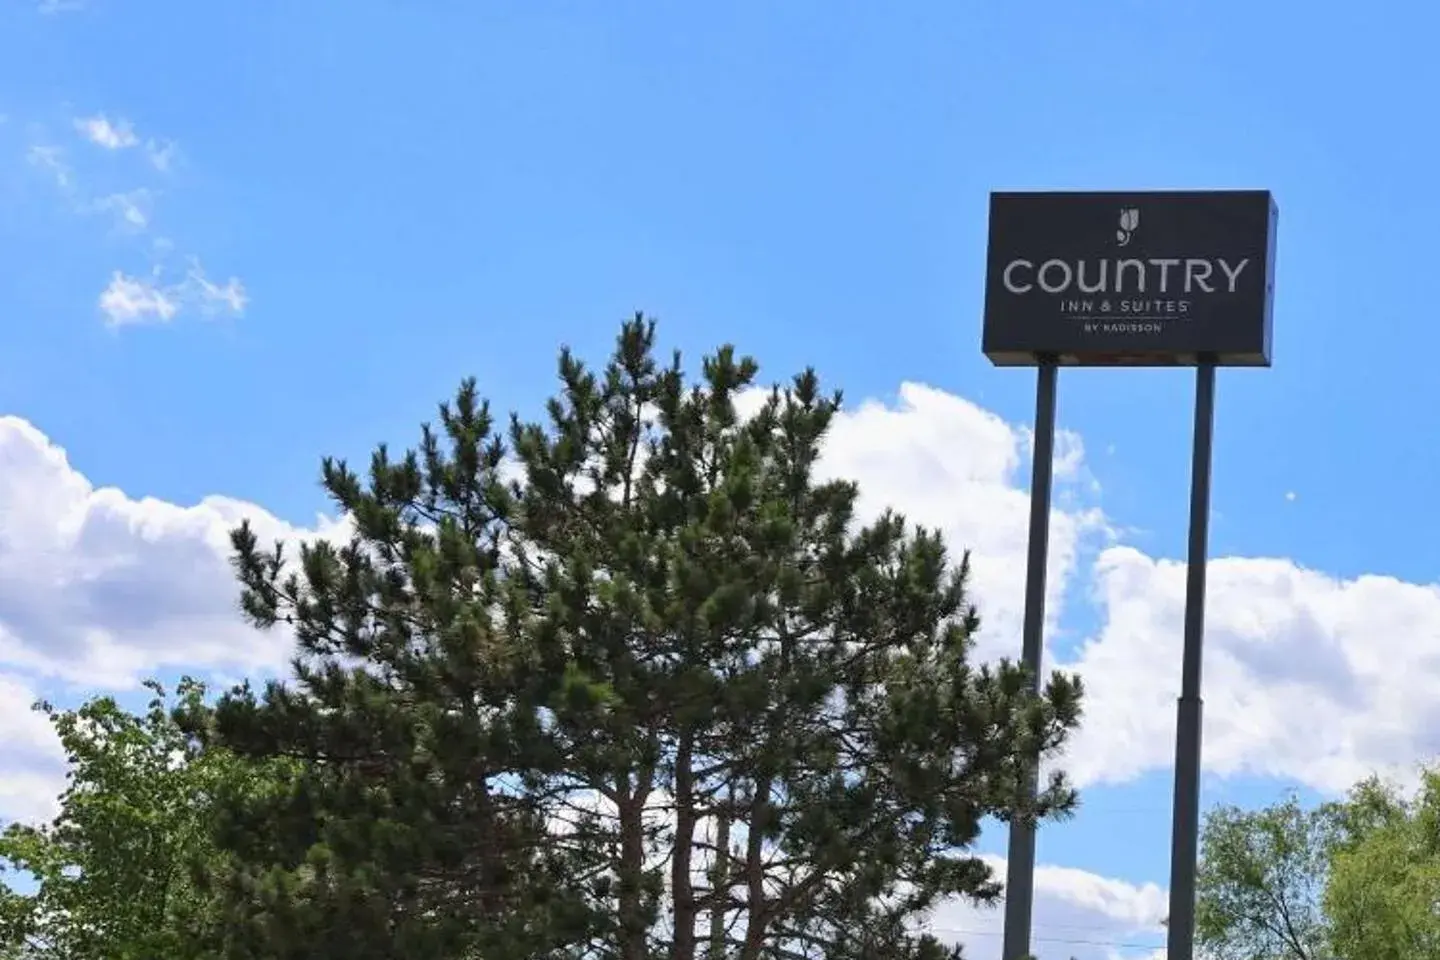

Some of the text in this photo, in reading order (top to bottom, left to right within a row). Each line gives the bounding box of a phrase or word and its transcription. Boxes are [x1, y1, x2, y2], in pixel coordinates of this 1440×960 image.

[1060, 300, 1189, 312] INN & SUITES
